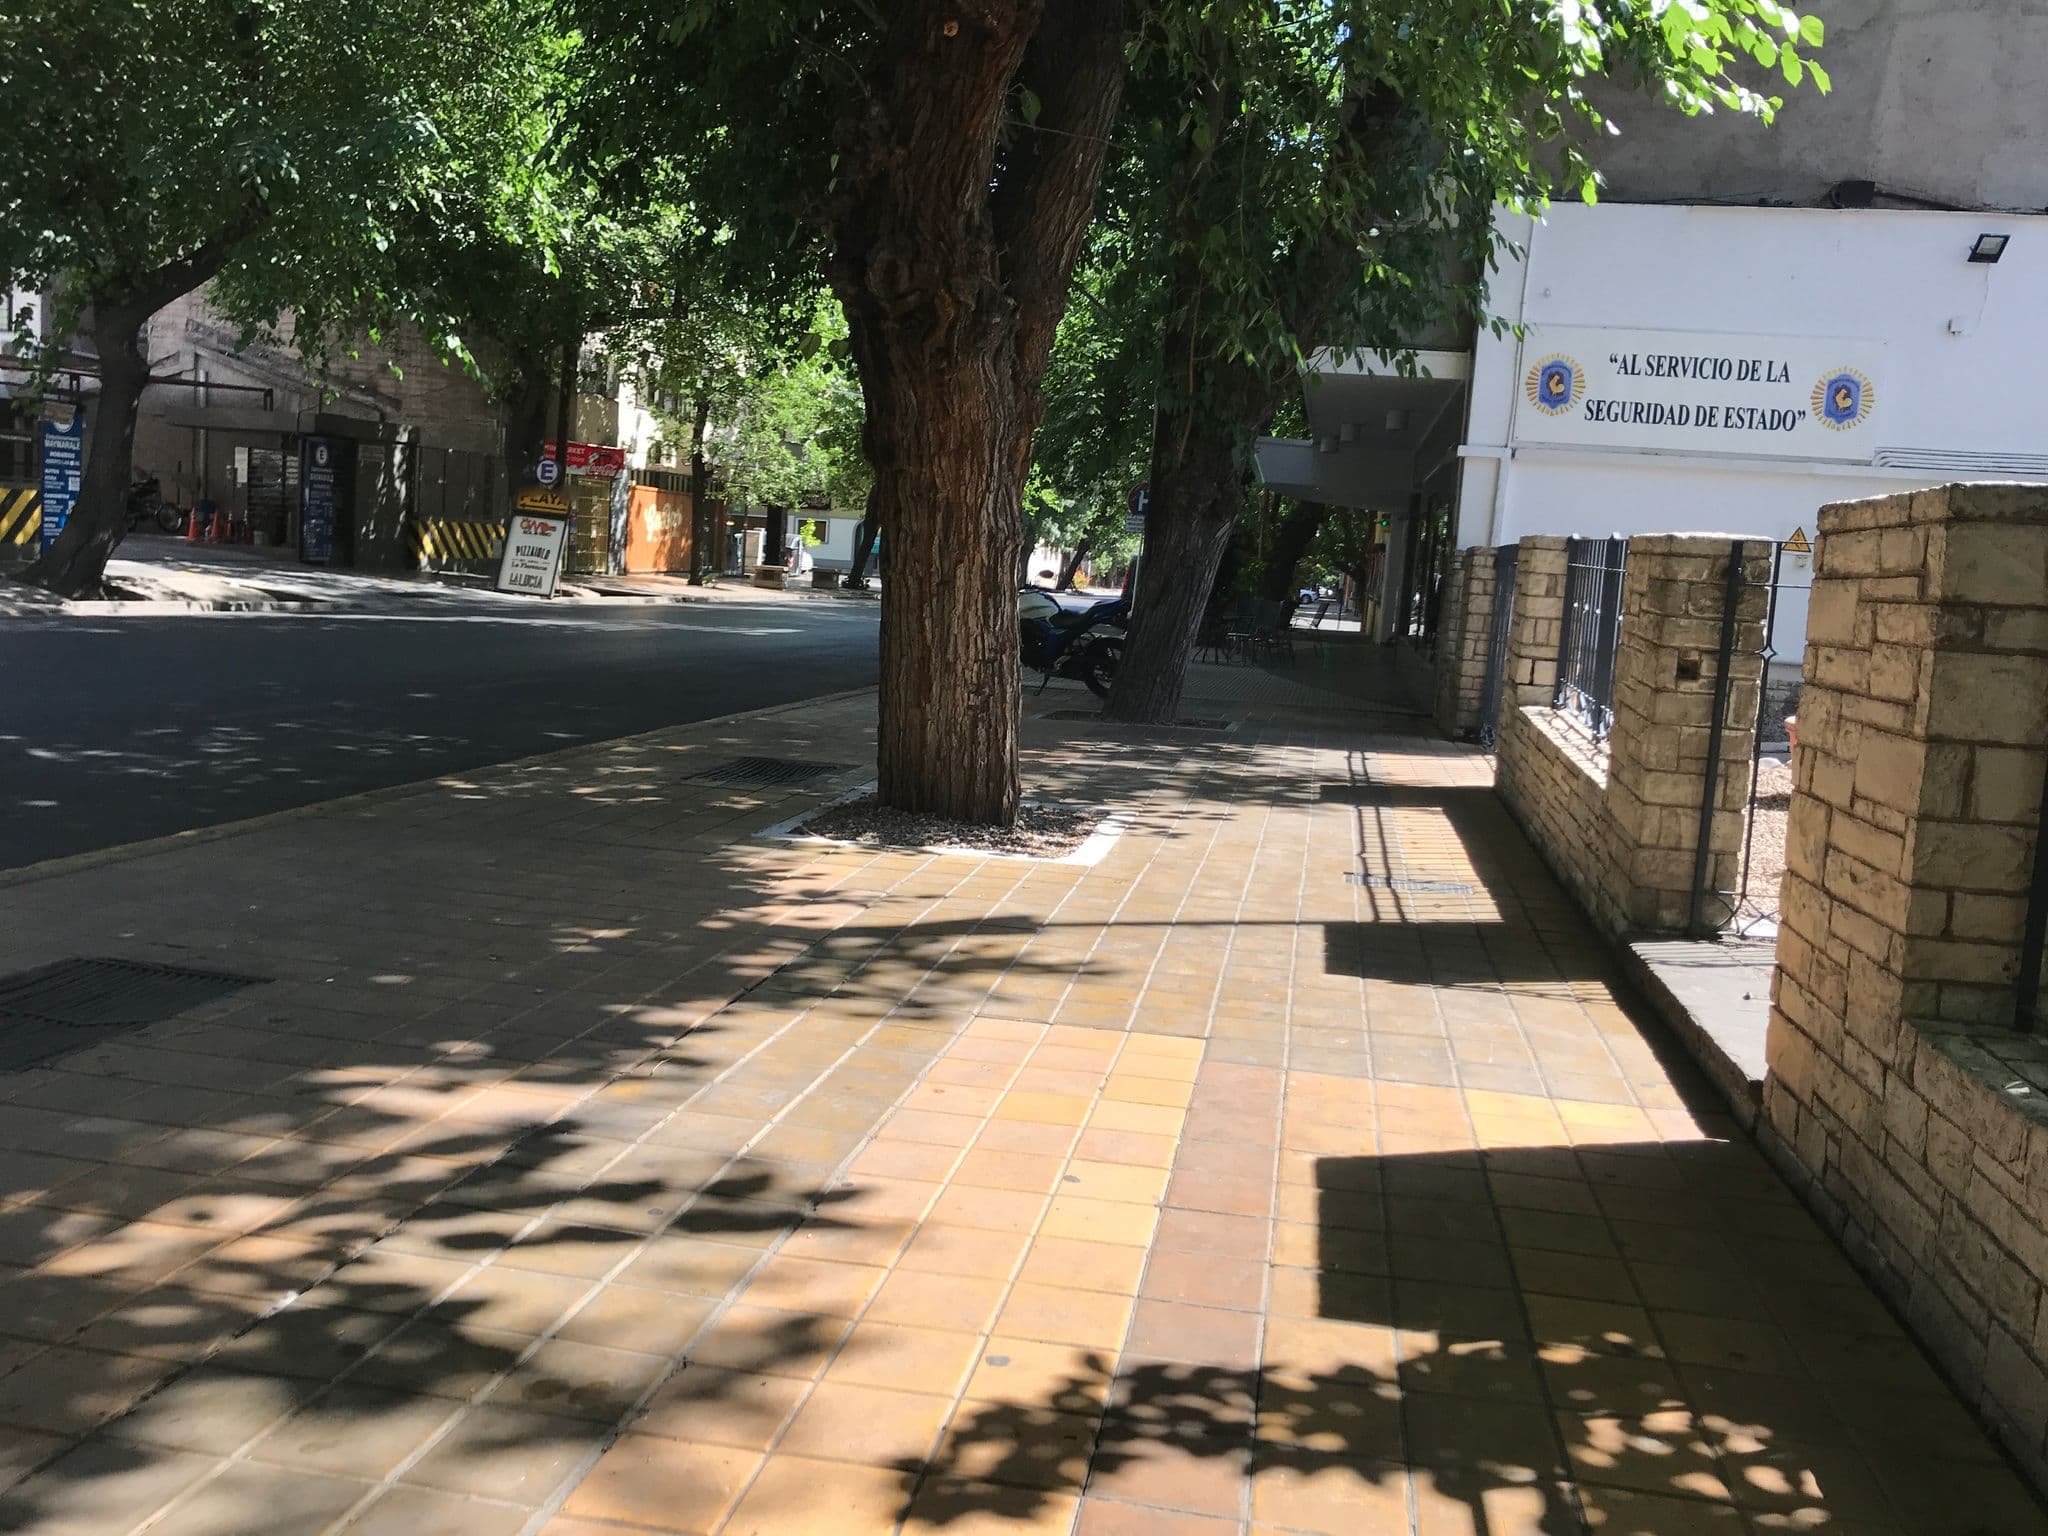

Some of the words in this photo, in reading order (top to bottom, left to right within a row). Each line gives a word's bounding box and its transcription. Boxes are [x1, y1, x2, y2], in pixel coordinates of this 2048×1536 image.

[1645, 354, 1732, 382] SERVICIO
[1736, 359, 1762, 382] DE
[1766, 361, 1790, 383] LA
[1584, 399, 1690, 426] SEGURIDAD
[1694, 405, 1719, 428] DE
[541, 463, 554, 480] E
